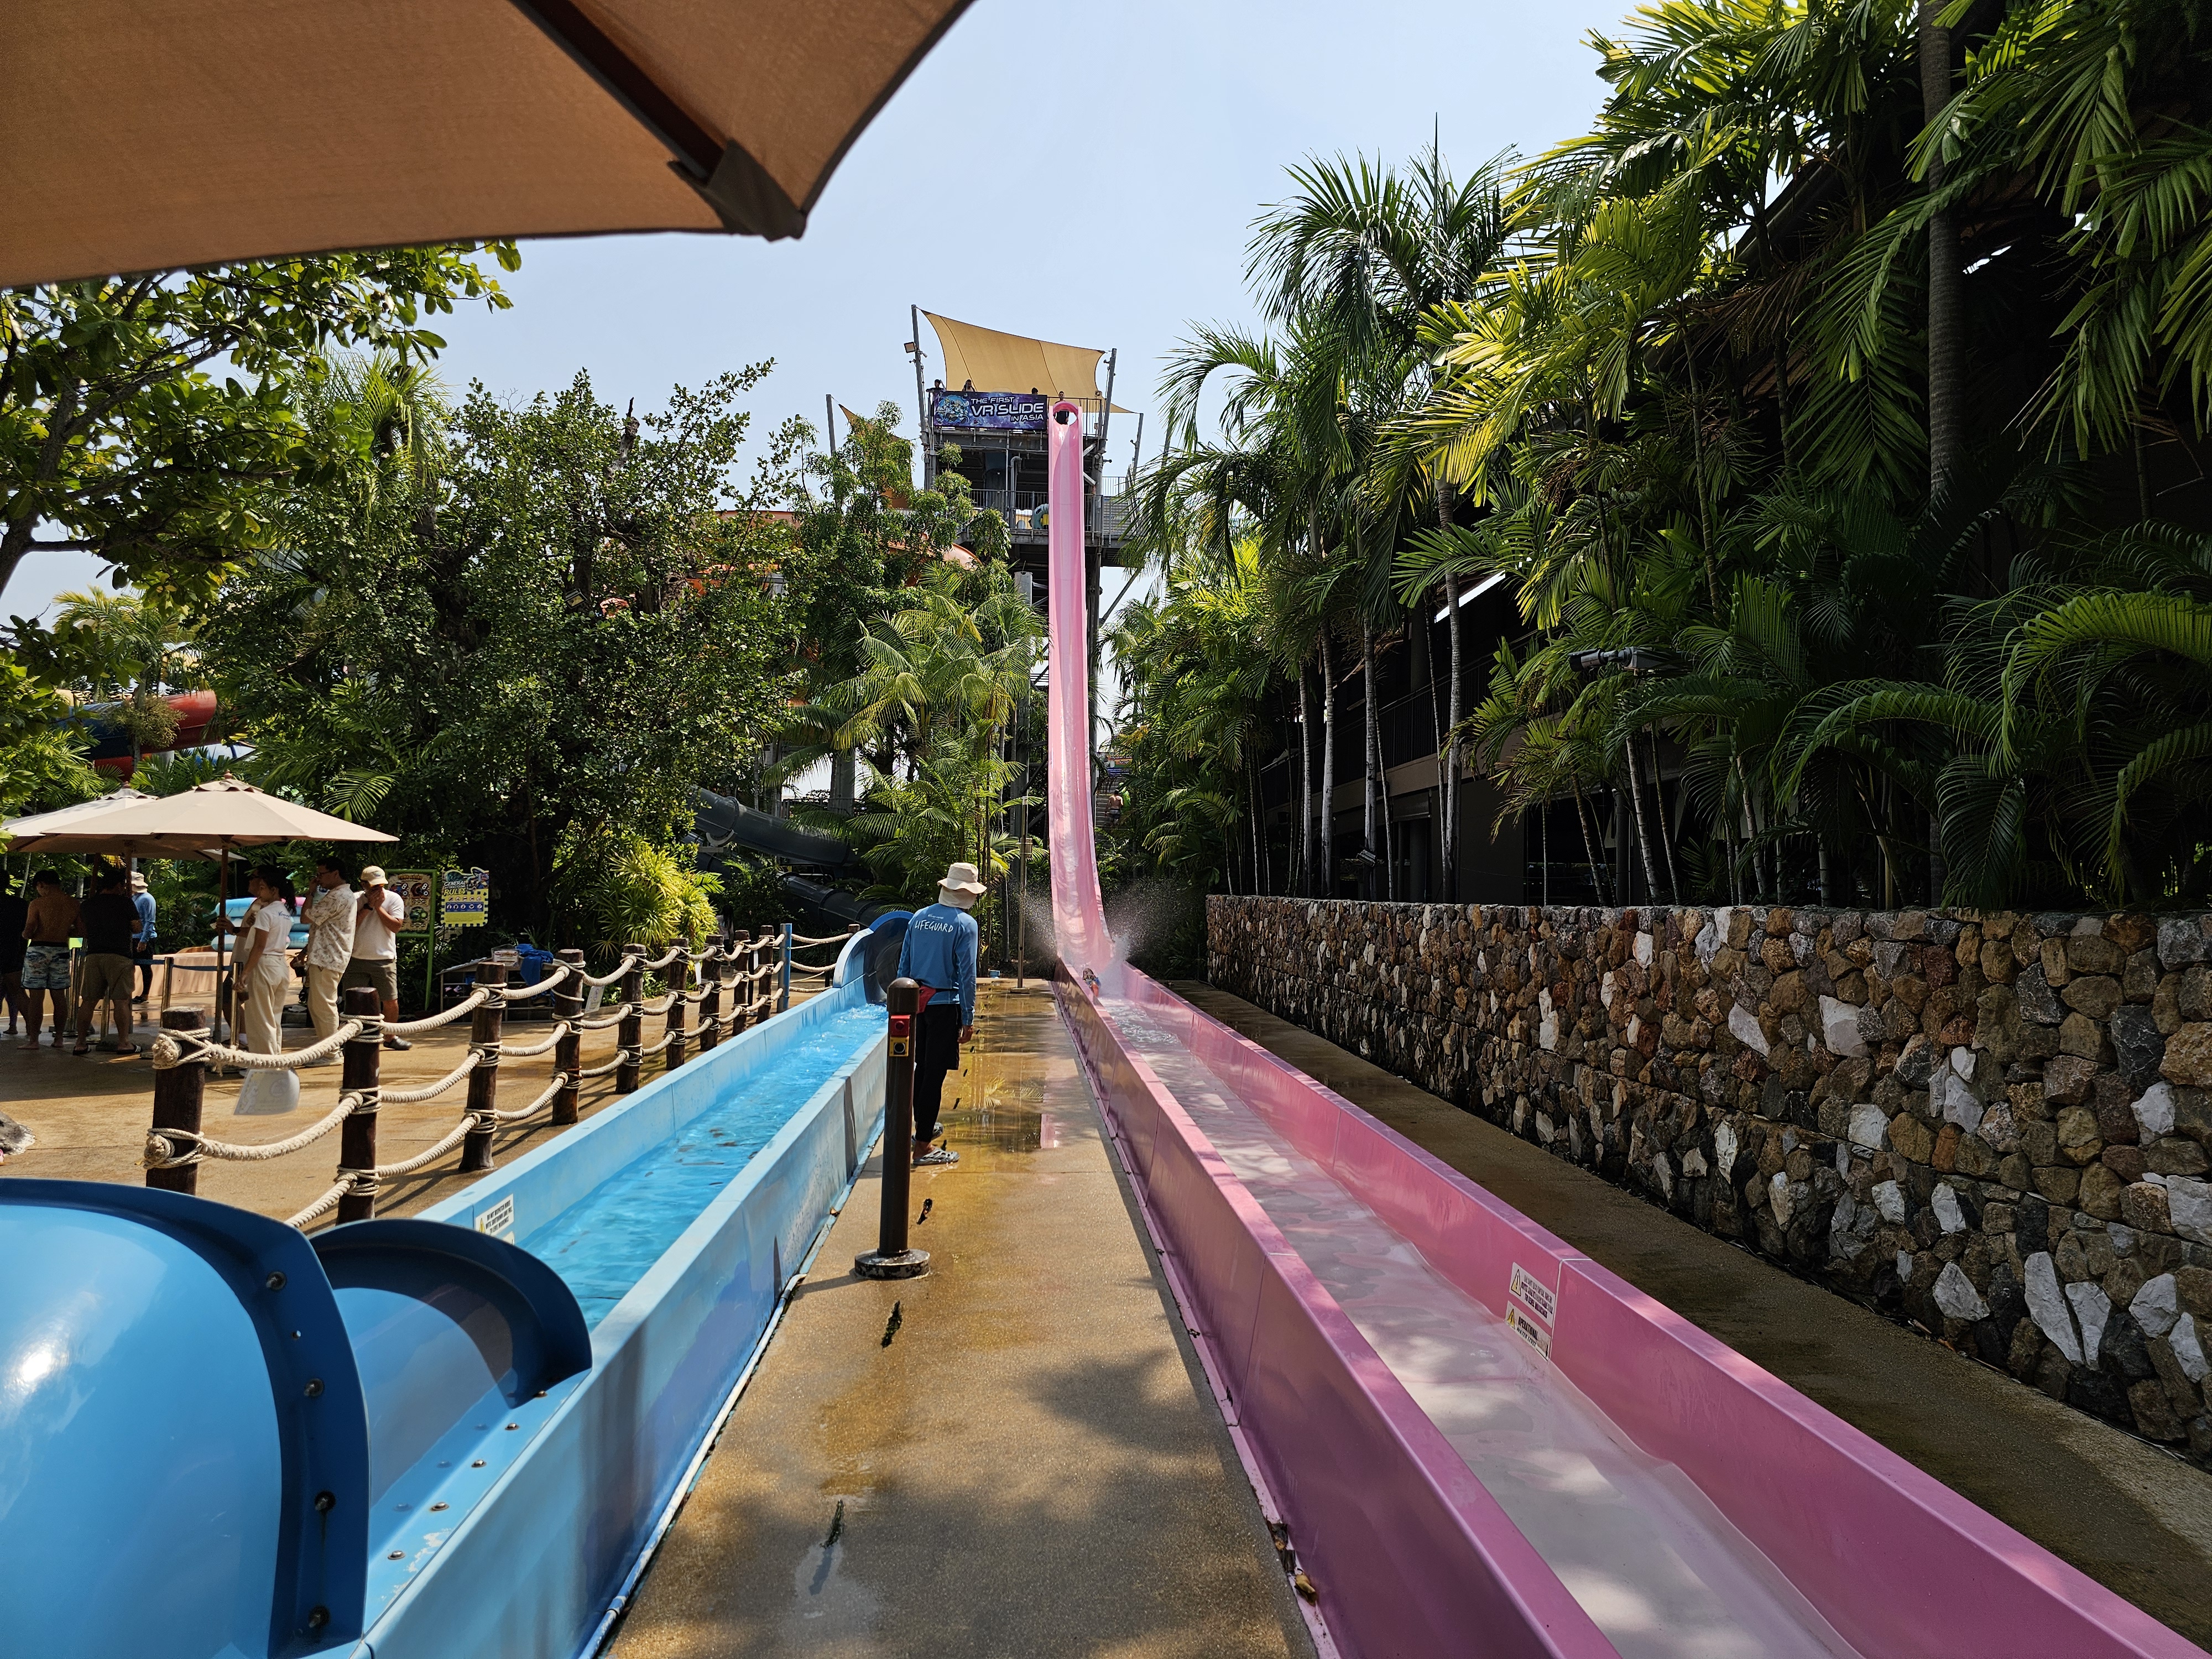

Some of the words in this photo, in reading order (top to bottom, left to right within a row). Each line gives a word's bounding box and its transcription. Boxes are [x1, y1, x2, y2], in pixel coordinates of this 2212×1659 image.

[971, 405, 993, 415] VR
[998, 403, 1044, 414] SLIDE
[444, 888, 466, 896] RULES
[915, 920, 953, 932] LIFEGUARD
[1518, 1317, 1538, 1340] OPERATIONAL
